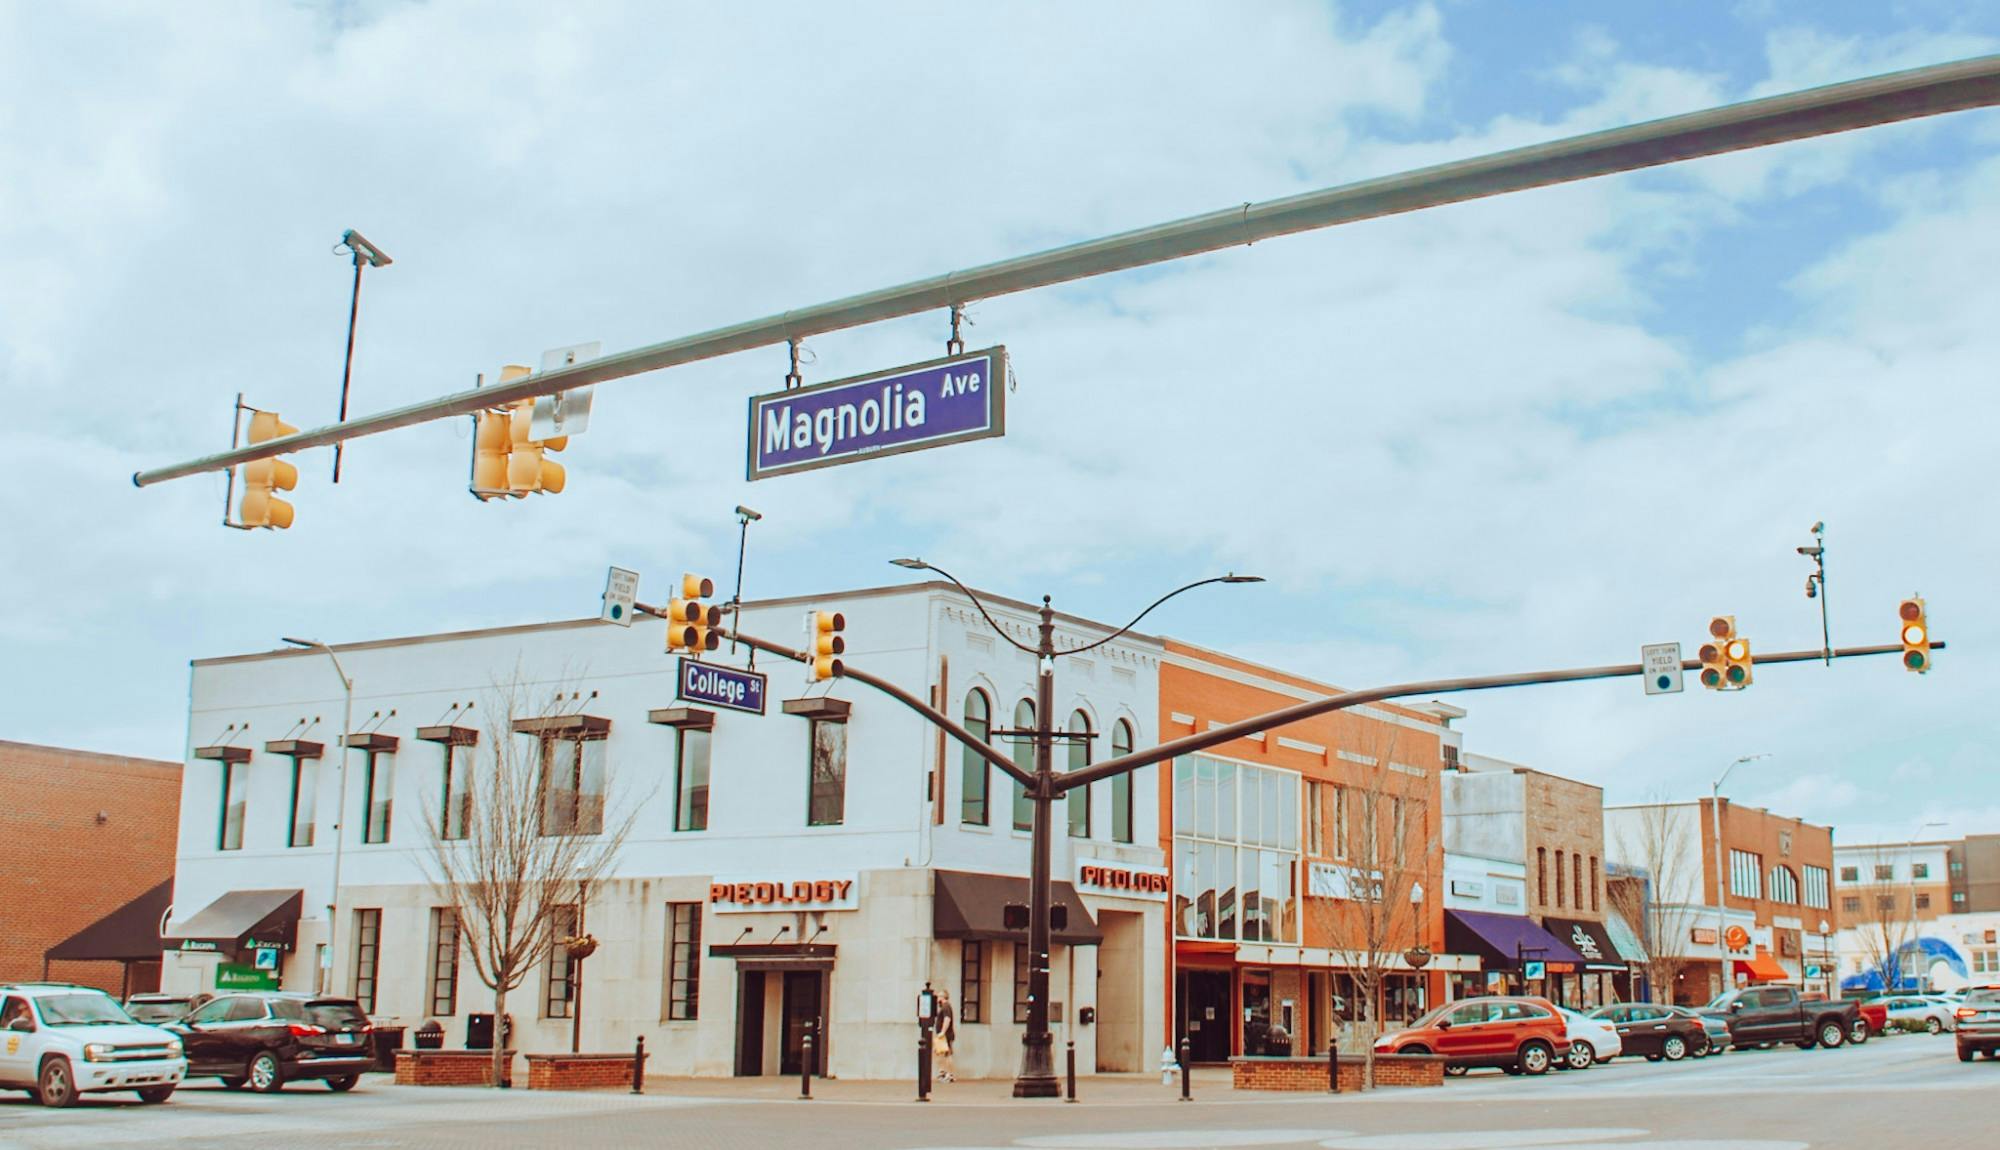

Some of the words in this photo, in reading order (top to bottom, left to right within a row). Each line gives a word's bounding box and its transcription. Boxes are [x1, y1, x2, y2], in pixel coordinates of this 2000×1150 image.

[765, 383, 926, 455] Magnolia
[941, 372, 981, 399] Ave
[687, 666, 745, 704] College
[750, 679, 760, 693] St
[709, 880, 853, 905] PIEOLOGY
[1080, 866, 1172, 893] PIEOLOGY
